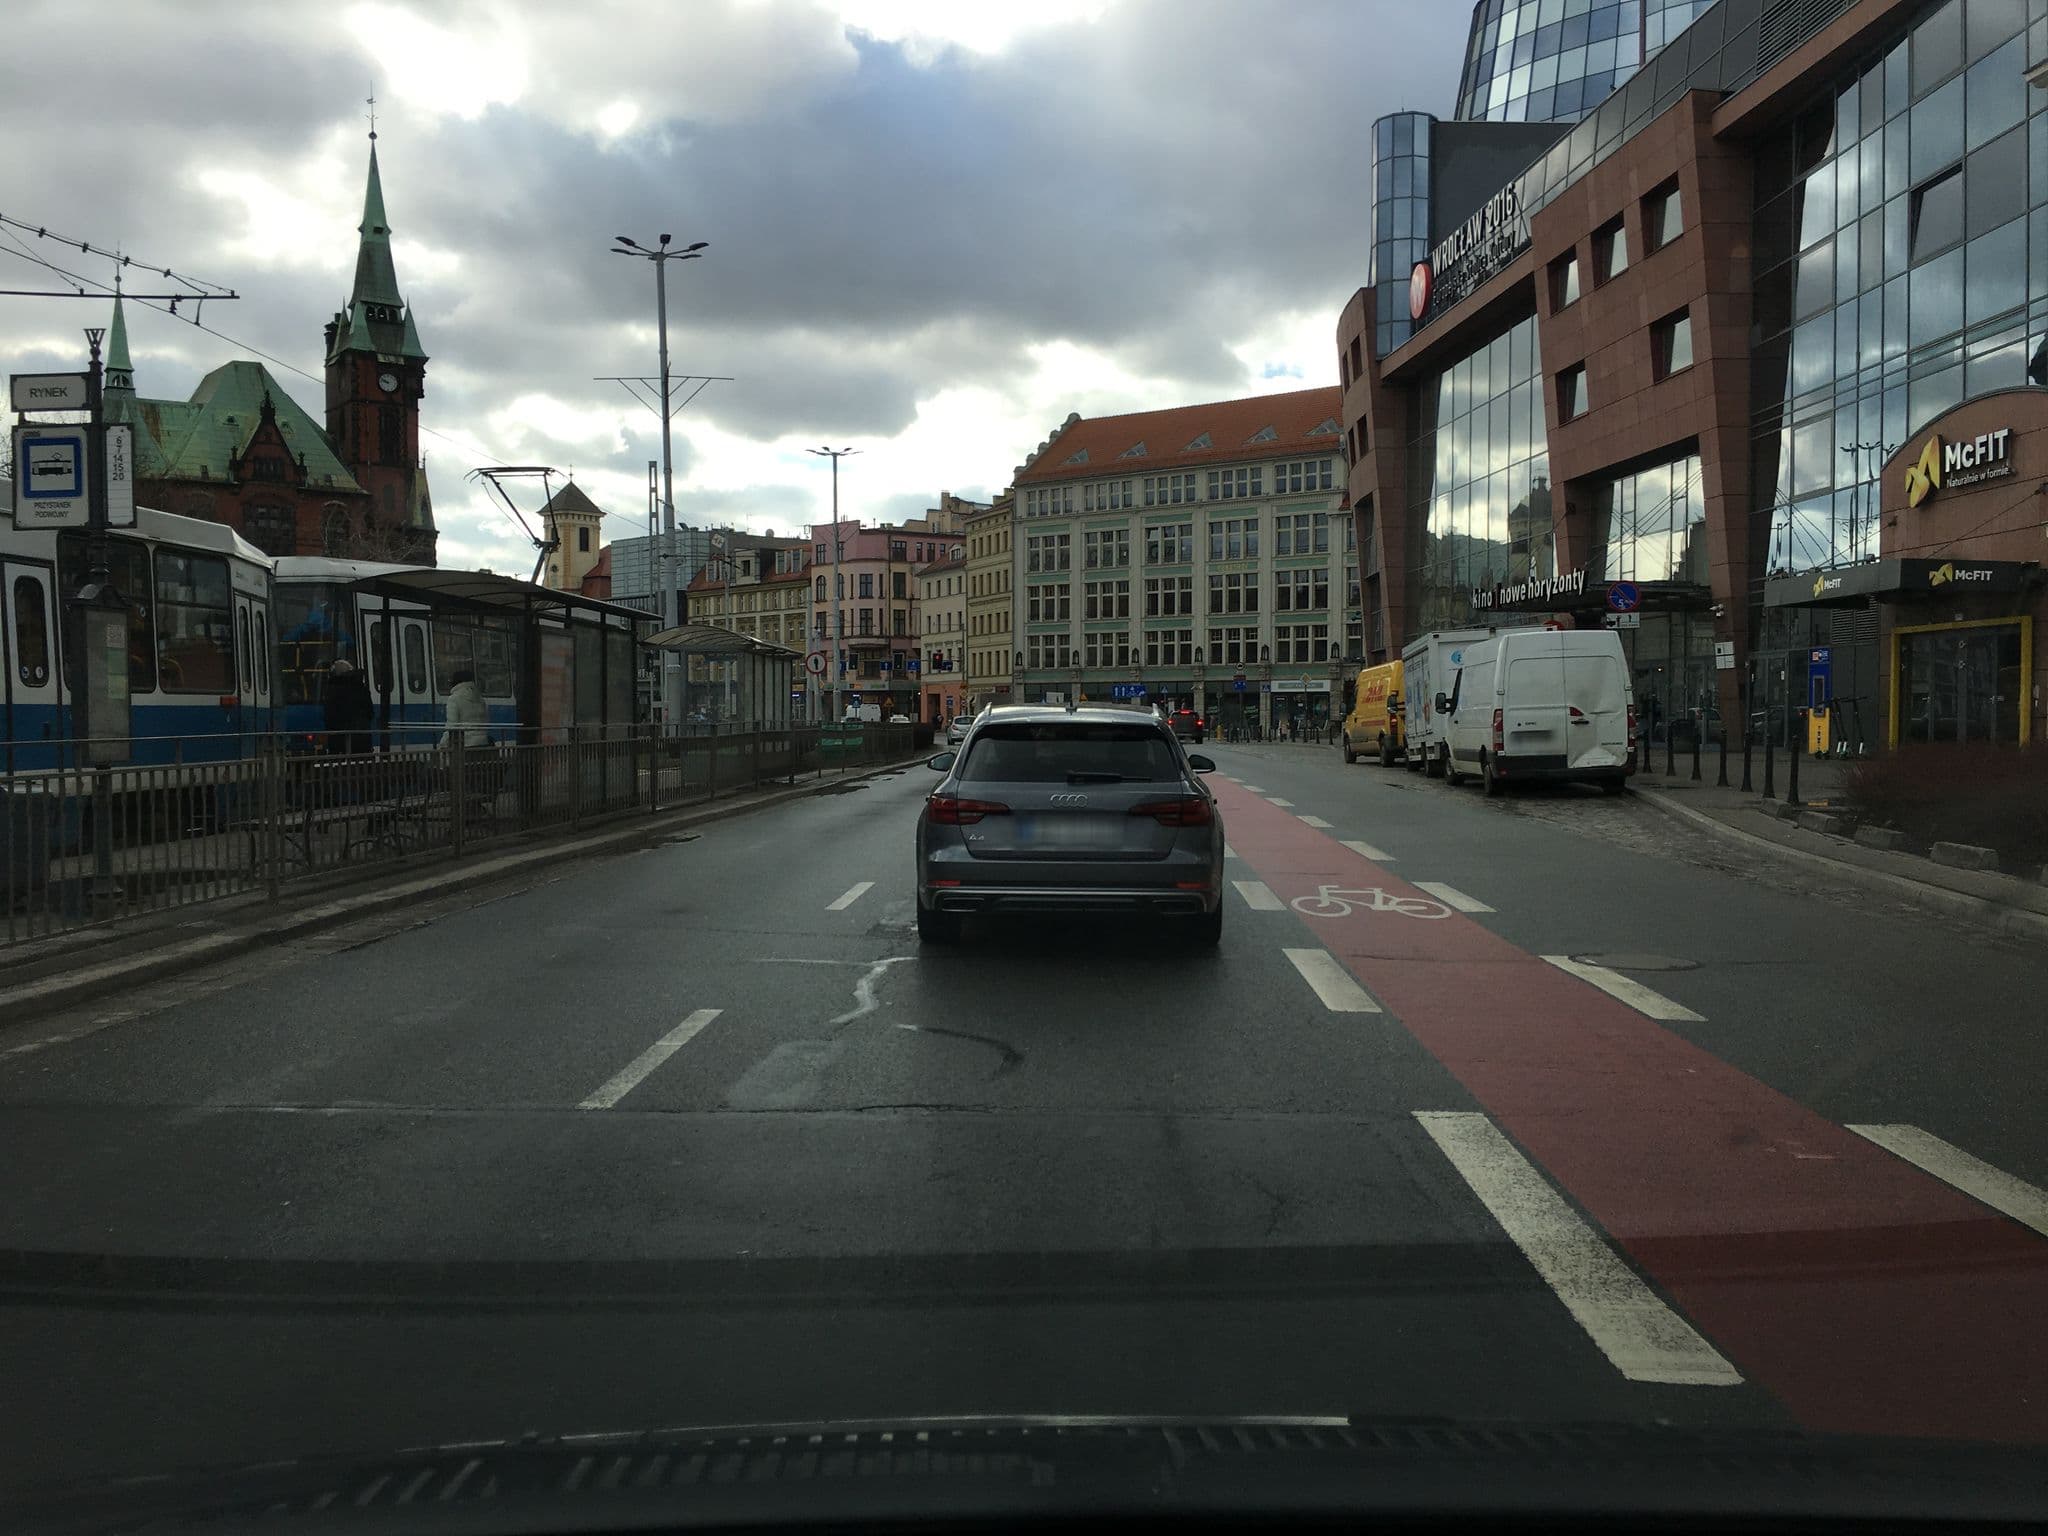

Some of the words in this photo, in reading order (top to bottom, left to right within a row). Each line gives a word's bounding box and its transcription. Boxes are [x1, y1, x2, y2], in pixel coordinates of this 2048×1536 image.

[1432, 208, 1483, 278] WROCŁAW
[1486, 182, 1513, 233] 2016
[29, 387, 68, 399] RYNEK
[115, 436, 122, 445] 6
[113, 454, 123, 463] 14
[113, 463, 124, 472] 15
[112, 472, 125, 481] 20
[1980, 472, 1986, 481] w
[1473, 588, 1493, 609] kino
[1500, 584, 1526, 605] nowe
[1527, 568, 1585, 602] horyzonty
